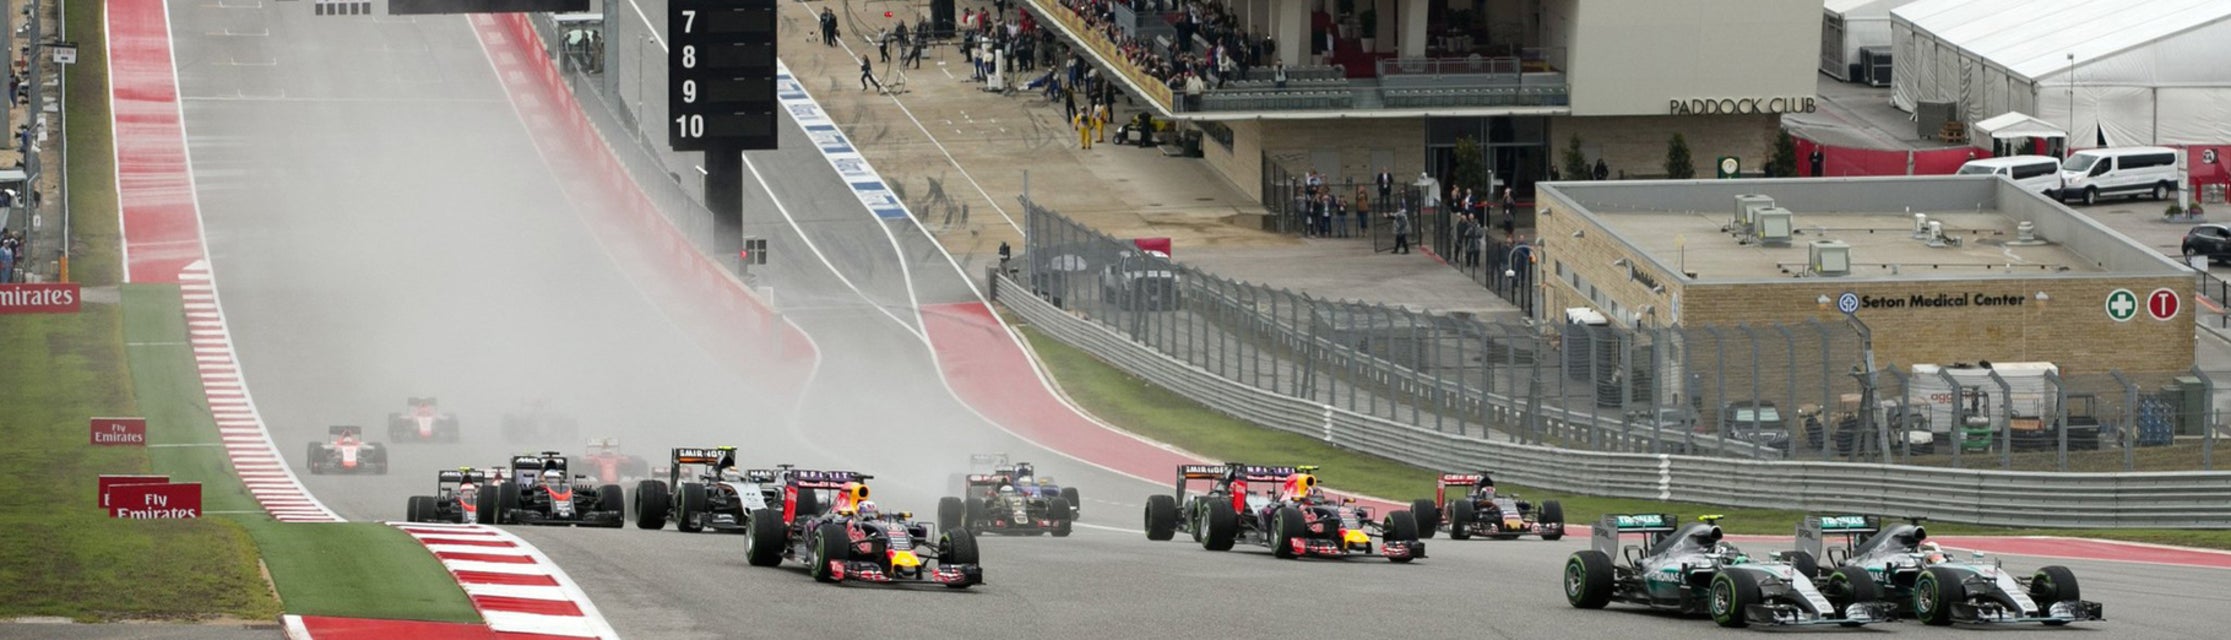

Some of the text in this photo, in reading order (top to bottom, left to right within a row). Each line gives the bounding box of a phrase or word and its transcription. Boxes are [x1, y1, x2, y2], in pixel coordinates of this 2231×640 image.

[682, 10, 696, 33] 7
[682, 45, 696, 69] 8
[682, 79, 696, 103] 9
[1670, 97, 1817, 115] PADDOCK CLUB
[676, 114, 704, 138] 10
[0, 286, 73, 305] mirates
[1862, 292, 2025, 309] Seton Medical Center
[95, 431, 143, 442] Emirates
[112, 424, 126, 432] Fly
[145, 494, 168, 507] Fly
[117, 507, 196, 519] Emirates
